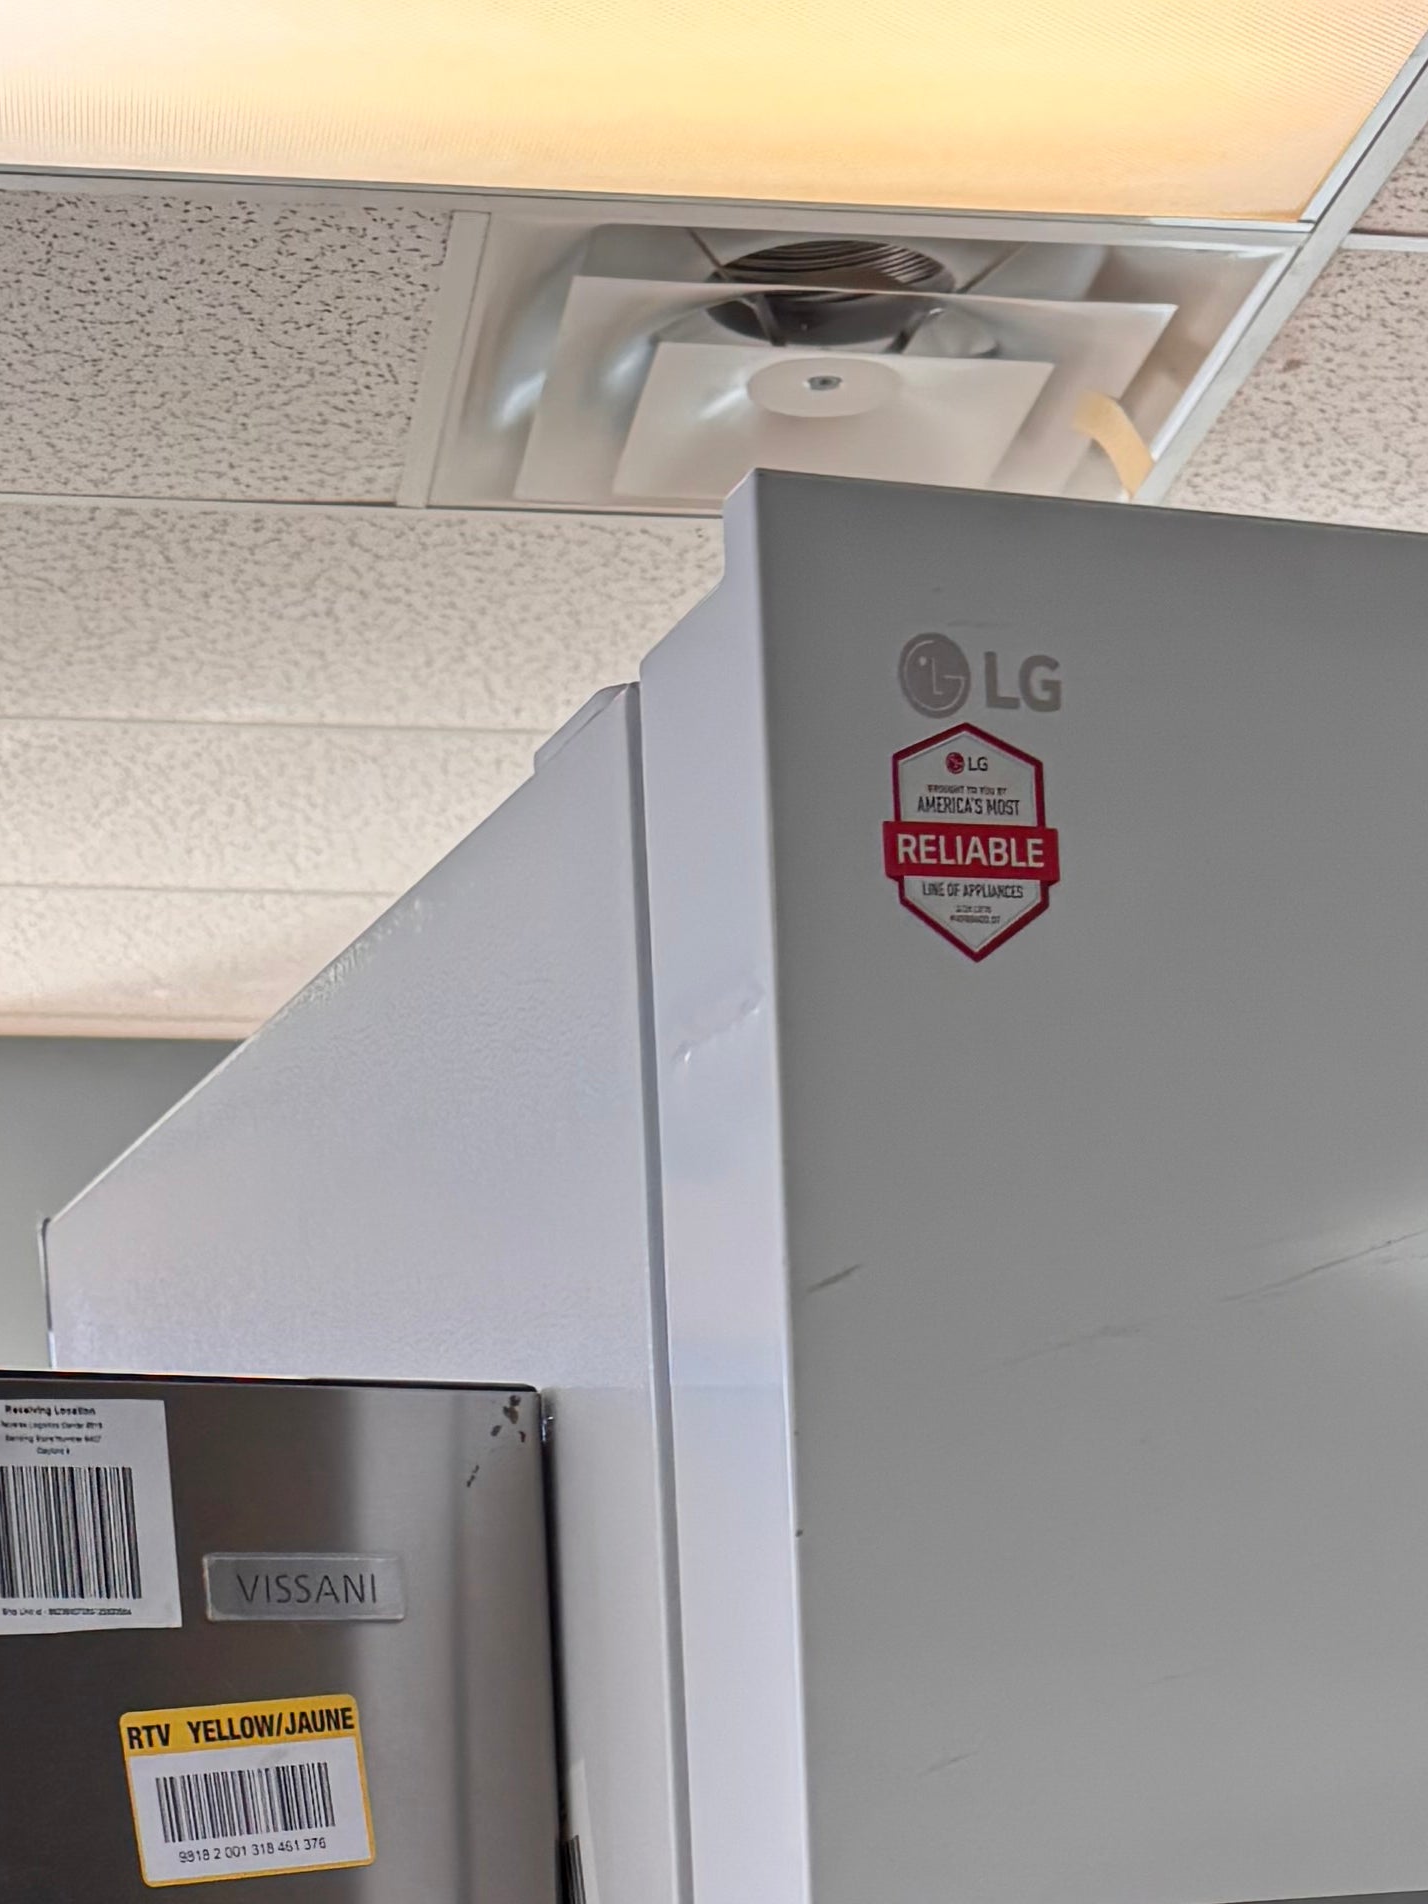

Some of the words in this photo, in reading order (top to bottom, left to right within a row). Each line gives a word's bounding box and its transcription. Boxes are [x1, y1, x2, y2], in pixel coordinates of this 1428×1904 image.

[984, 651, 1062, 713] LG
[968, 756, 989, 772] LG
[917, 796, 984, 815] AMERICA'S
[986, 799, 1020, 816] MOST
[897, 833, 1045, 868] RELIABLE
[947, 883, 960, 897] OF
[962, 884, 1024, 898] APPLIANCES
[237, 1573, 378, 1604] VISSANI
[127, 1723, 172, 1750] RTV
[186, 1706, 355, 1744] YELLOW/JAUNE
